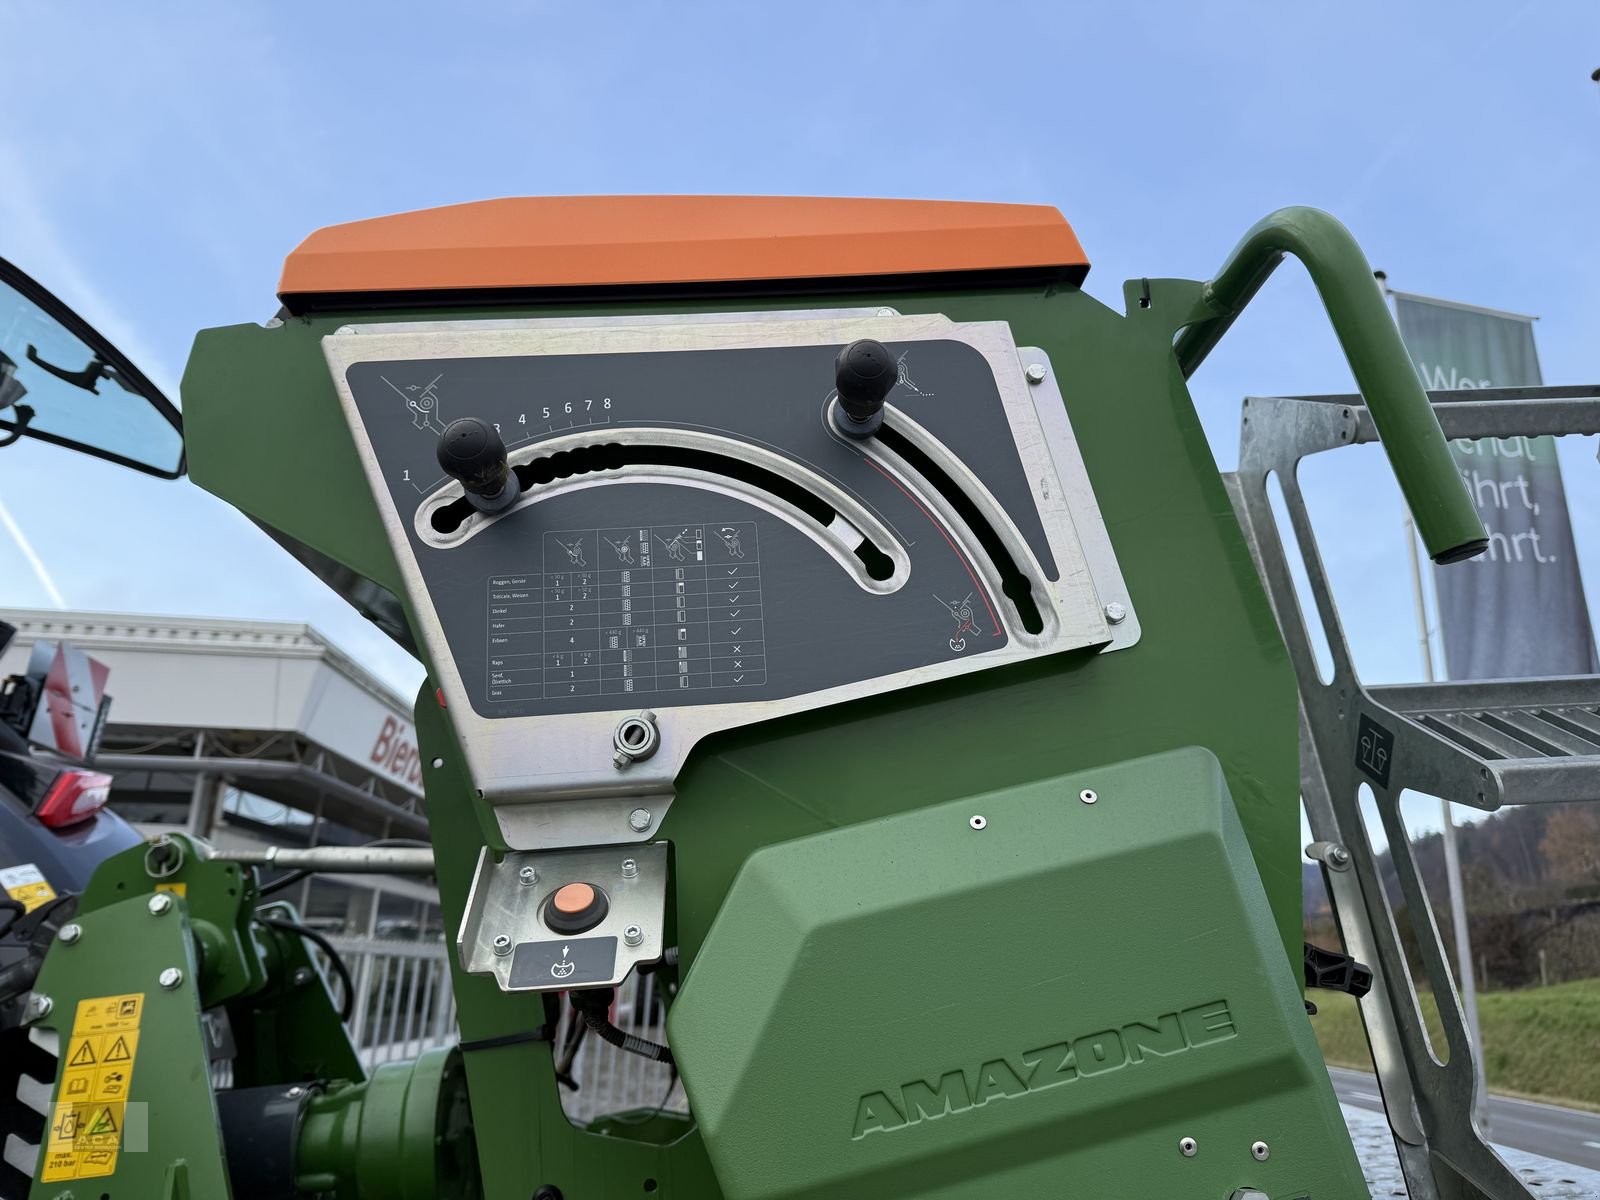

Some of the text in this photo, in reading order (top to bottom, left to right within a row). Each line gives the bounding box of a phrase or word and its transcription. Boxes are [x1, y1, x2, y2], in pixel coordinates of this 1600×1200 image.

[403, 470, 410, 481] 1
[518, 414, 526, 424] 4
[542, 408, 550, 419] 5
[564, 402, 572, 414] 6
[585, 400, 592, 411] 7
[604, 398, 612, 409] 8
[1462, 469, 1540, 516] hrt,
[852, 998, 1238, 1141] AMAZONE
[48, 1160, 62, 1168] 210
